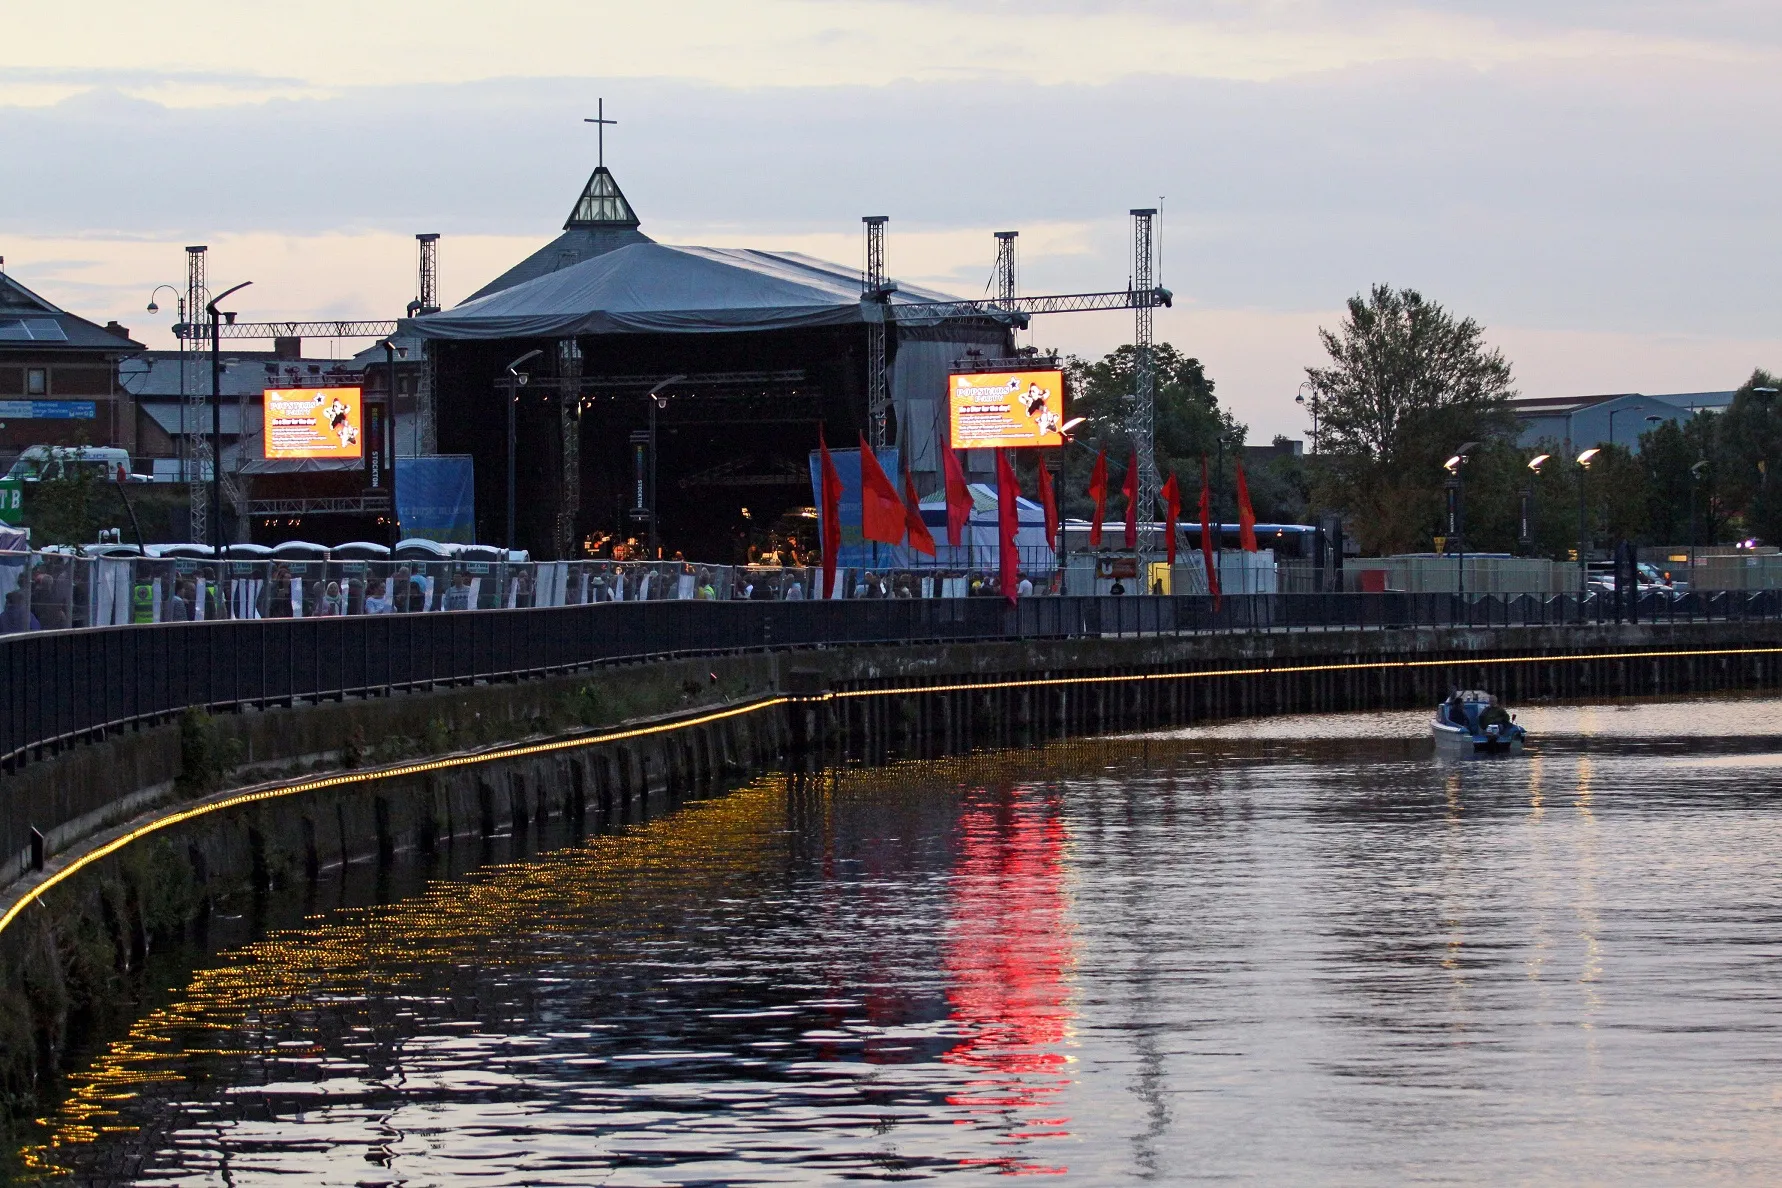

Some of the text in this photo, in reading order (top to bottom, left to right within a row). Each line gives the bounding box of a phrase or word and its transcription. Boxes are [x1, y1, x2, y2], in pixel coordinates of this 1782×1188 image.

[956, 386, 1010, 397] POPSTARS
[975, 394, 1004, 403] PARTY
[270, 401, 316, 411] POPSTARS
[286, 408, 311, 416] PARTY
